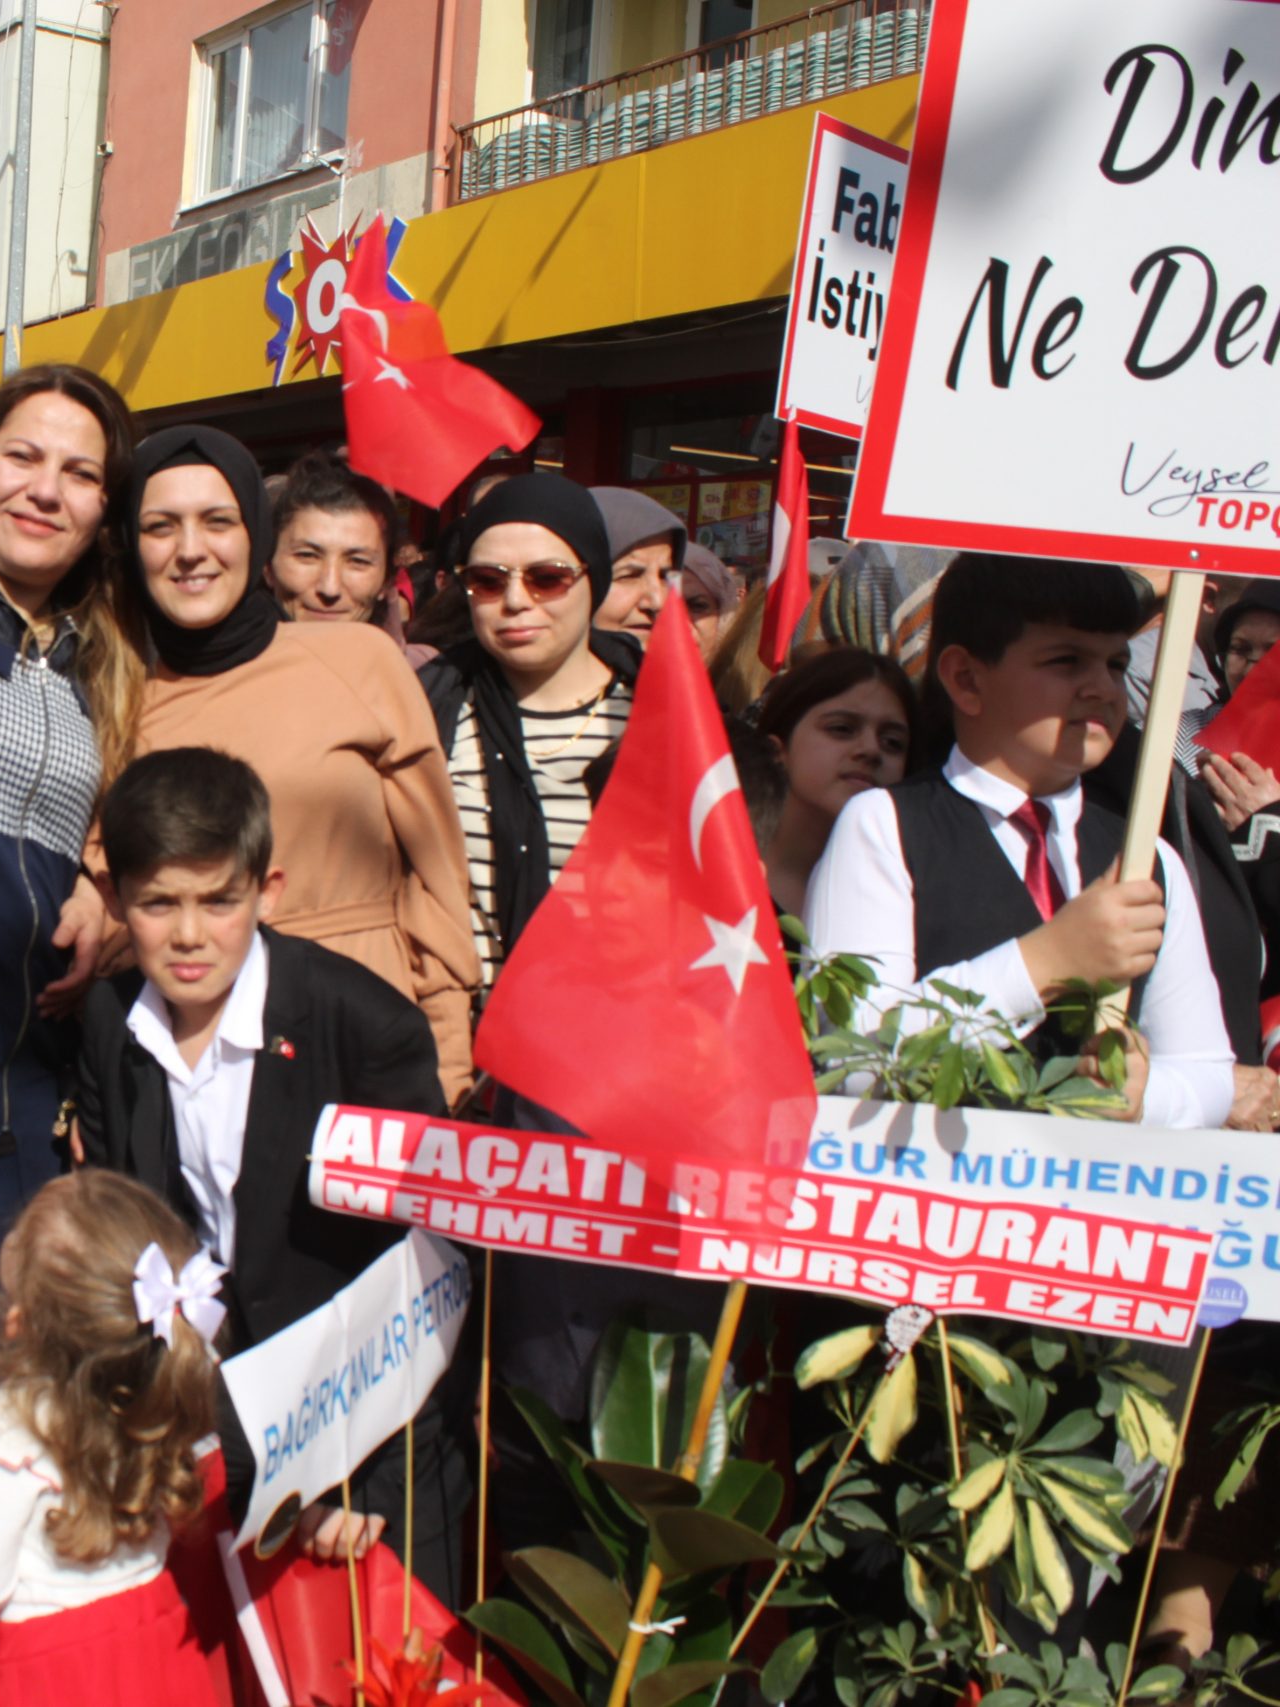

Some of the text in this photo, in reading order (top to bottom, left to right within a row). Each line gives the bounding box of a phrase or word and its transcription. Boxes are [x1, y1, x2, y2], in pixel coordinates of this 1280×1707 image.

[945, 255, 1084, 391] Ne
[1121, 441, 1270, 518] Veysel
[325, 1113, 1210, 1291] ALAÇATI RESTAURANT
[950, 1149, 1280, 1209] MÜHENDİS
[325, 1179, 637, 1257] MEHMET
[699, 1238, 986, 1308] NURSEL
[1006, 1280, 1196, 1338] EZEN
